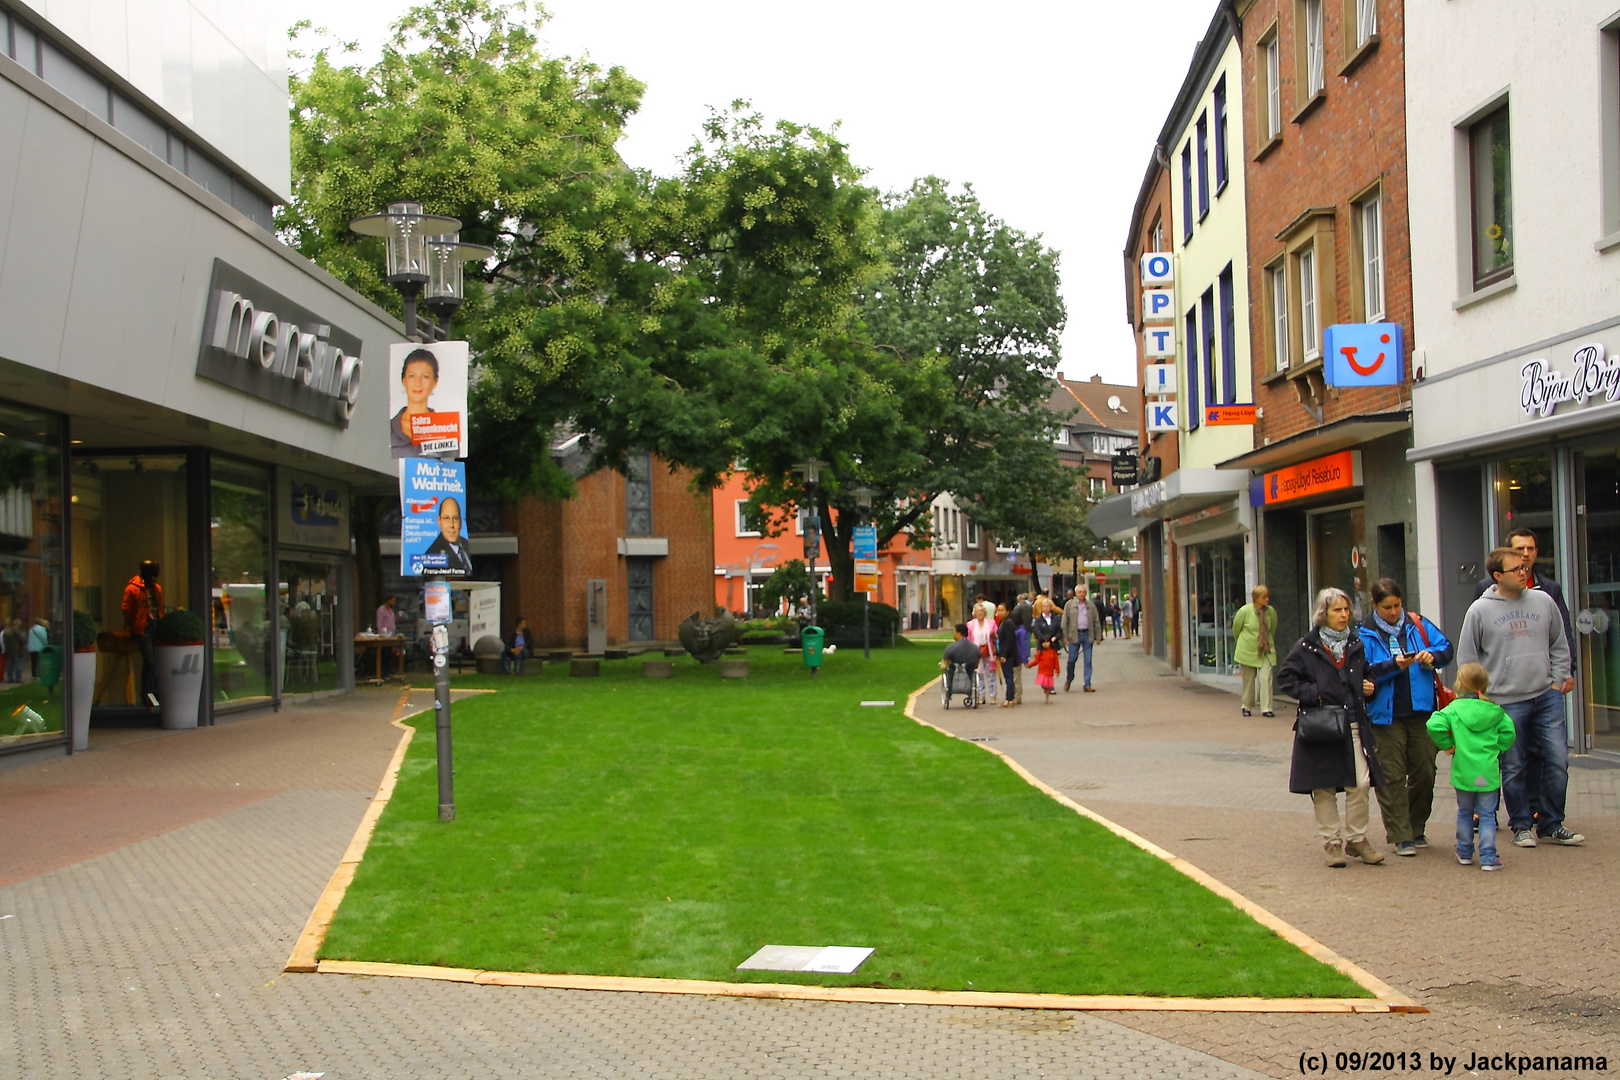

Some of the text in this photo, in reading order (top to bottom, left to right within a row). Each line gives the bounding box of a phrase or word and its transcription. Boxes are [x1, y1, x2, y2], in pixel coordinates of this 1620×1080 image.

[1148, 256, 1175, 427] OPTIK
[212, 290, 363, 421] mensing
[1521, 361, 1570, 414] Bijou
[411, 416, 432, 426] Sahra
[412, 423, 458, 435] Wagenknecht
[423, 442, 434, 451] DIE
[416, 462, 458, 478] Mut zur
[411, 476, 464, 493] Wahrheit.
[1493, 610, 1541, 628] TIMBERLAND
[1509, 620, 1528, 630] 1973
